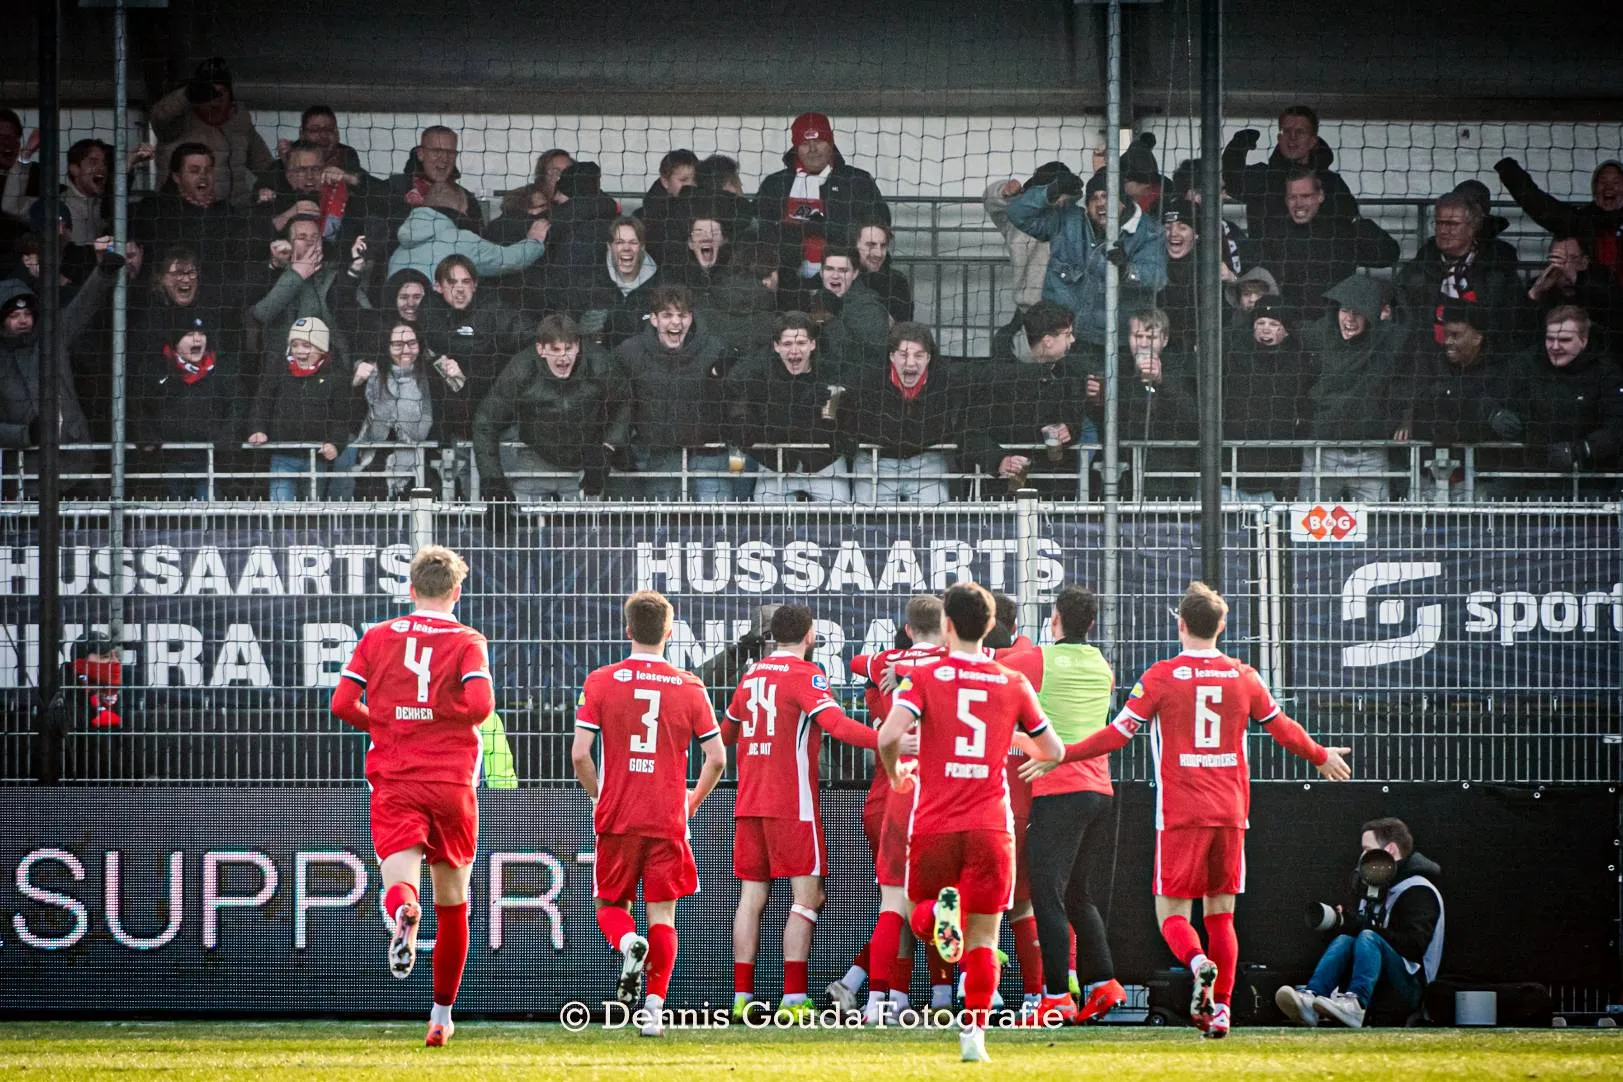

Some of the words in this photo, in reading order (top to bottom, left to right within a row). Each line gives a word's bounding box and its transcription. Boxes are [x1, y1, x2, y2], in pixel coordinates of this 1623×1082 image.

[0, 543, 412, 596] HUSSAARTS
[637, 539, 1064, 593] HUSSAARTS
[303, 622, 379, 687] B
[404, 636, 433, 703] 4
[636, 670, 683, 686] leaseweb
[958, 668, 1009, 685] leaseweb
[1195, 667, 1240, 679] leaseweb
[396, 706, 434, 720] DEKKER
[630, 688, 661, 754] 3
[743, 676, 777, 737] 34
[955, 688, 988, 758] 5
[1195, 685, 1222, 749] 6
[629, 757, 655, 774] GOES
[12, 847, 596, 950] SUPPR
